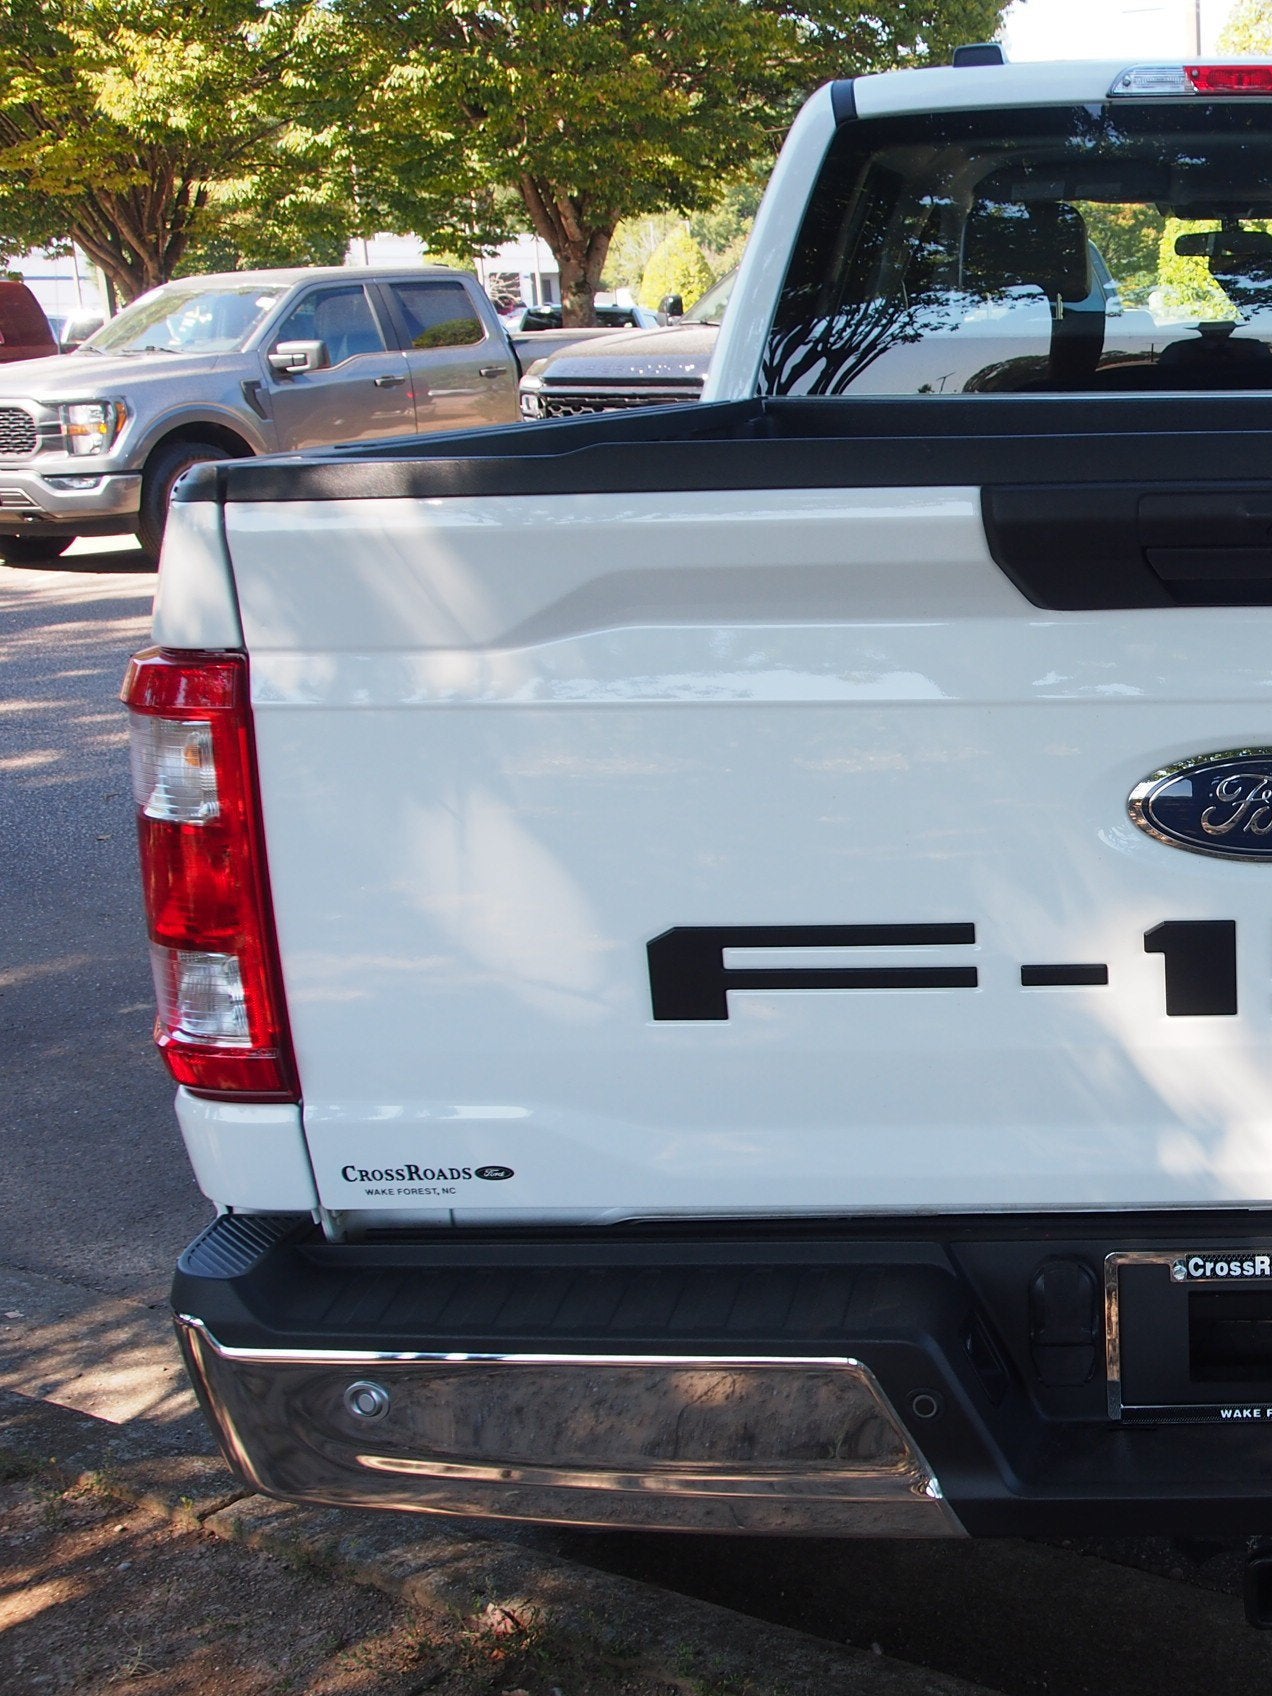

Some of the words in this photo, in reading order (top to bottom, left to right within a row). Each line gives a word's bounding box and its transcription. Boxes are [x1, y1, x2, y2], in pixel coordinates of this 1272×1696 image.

[365, 1188, 395, 1197] WAKE
[398, 1187, 440, 1196] FOREST,
[442, 1187, 456, 1195] NC
[1220, 1408, 1261, 1419] WAKE
